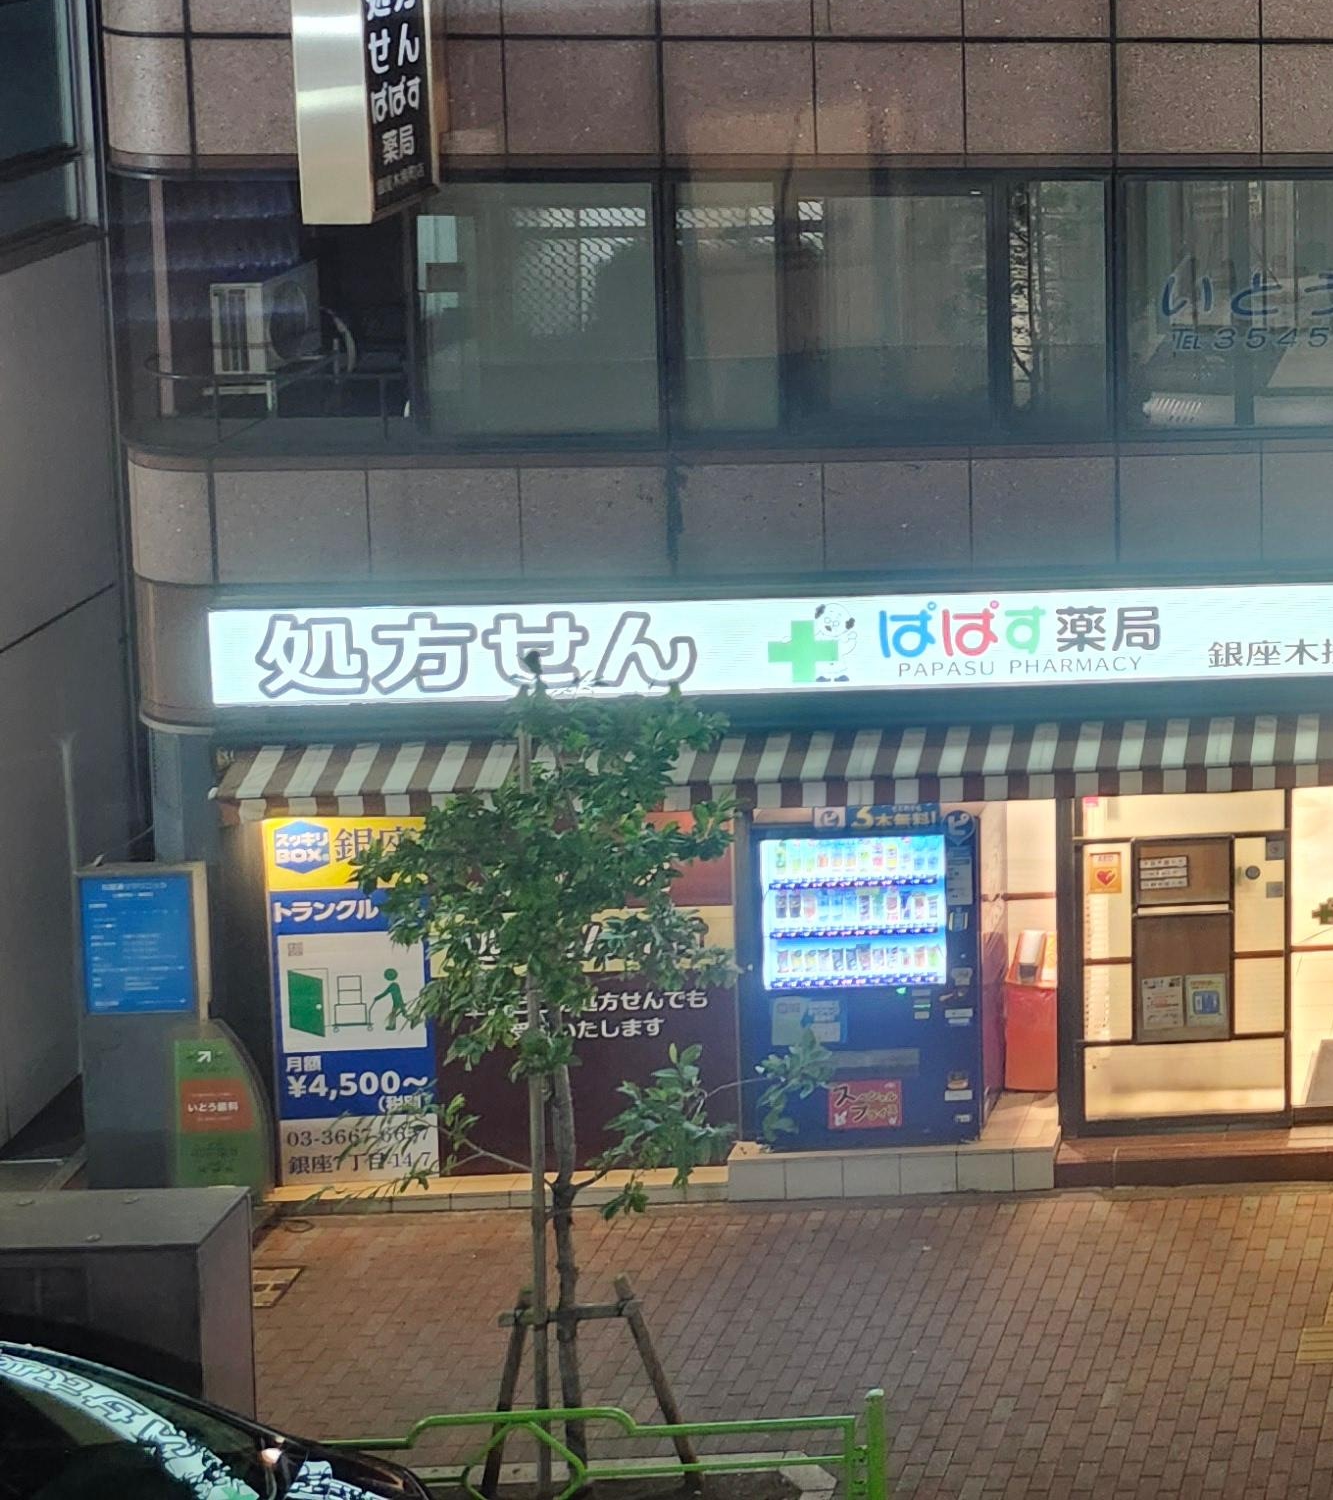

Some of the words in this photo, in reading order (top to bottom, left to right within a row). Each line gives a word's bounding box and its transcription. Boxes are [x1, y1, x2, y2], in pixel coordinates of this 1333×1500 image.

[368, 24, 420, 74] せん
[382, 125, 415, 166] 薬局
[878, 600, 1162, 659] ぱぱす薬局
[256, 610, 698, 698] 処方せん
[899, 660, 995, 677] PAPASU
[1010, 656, 1142, 674] PHARMACY
[287, 1071, 428, 1100] ¥4,500～
